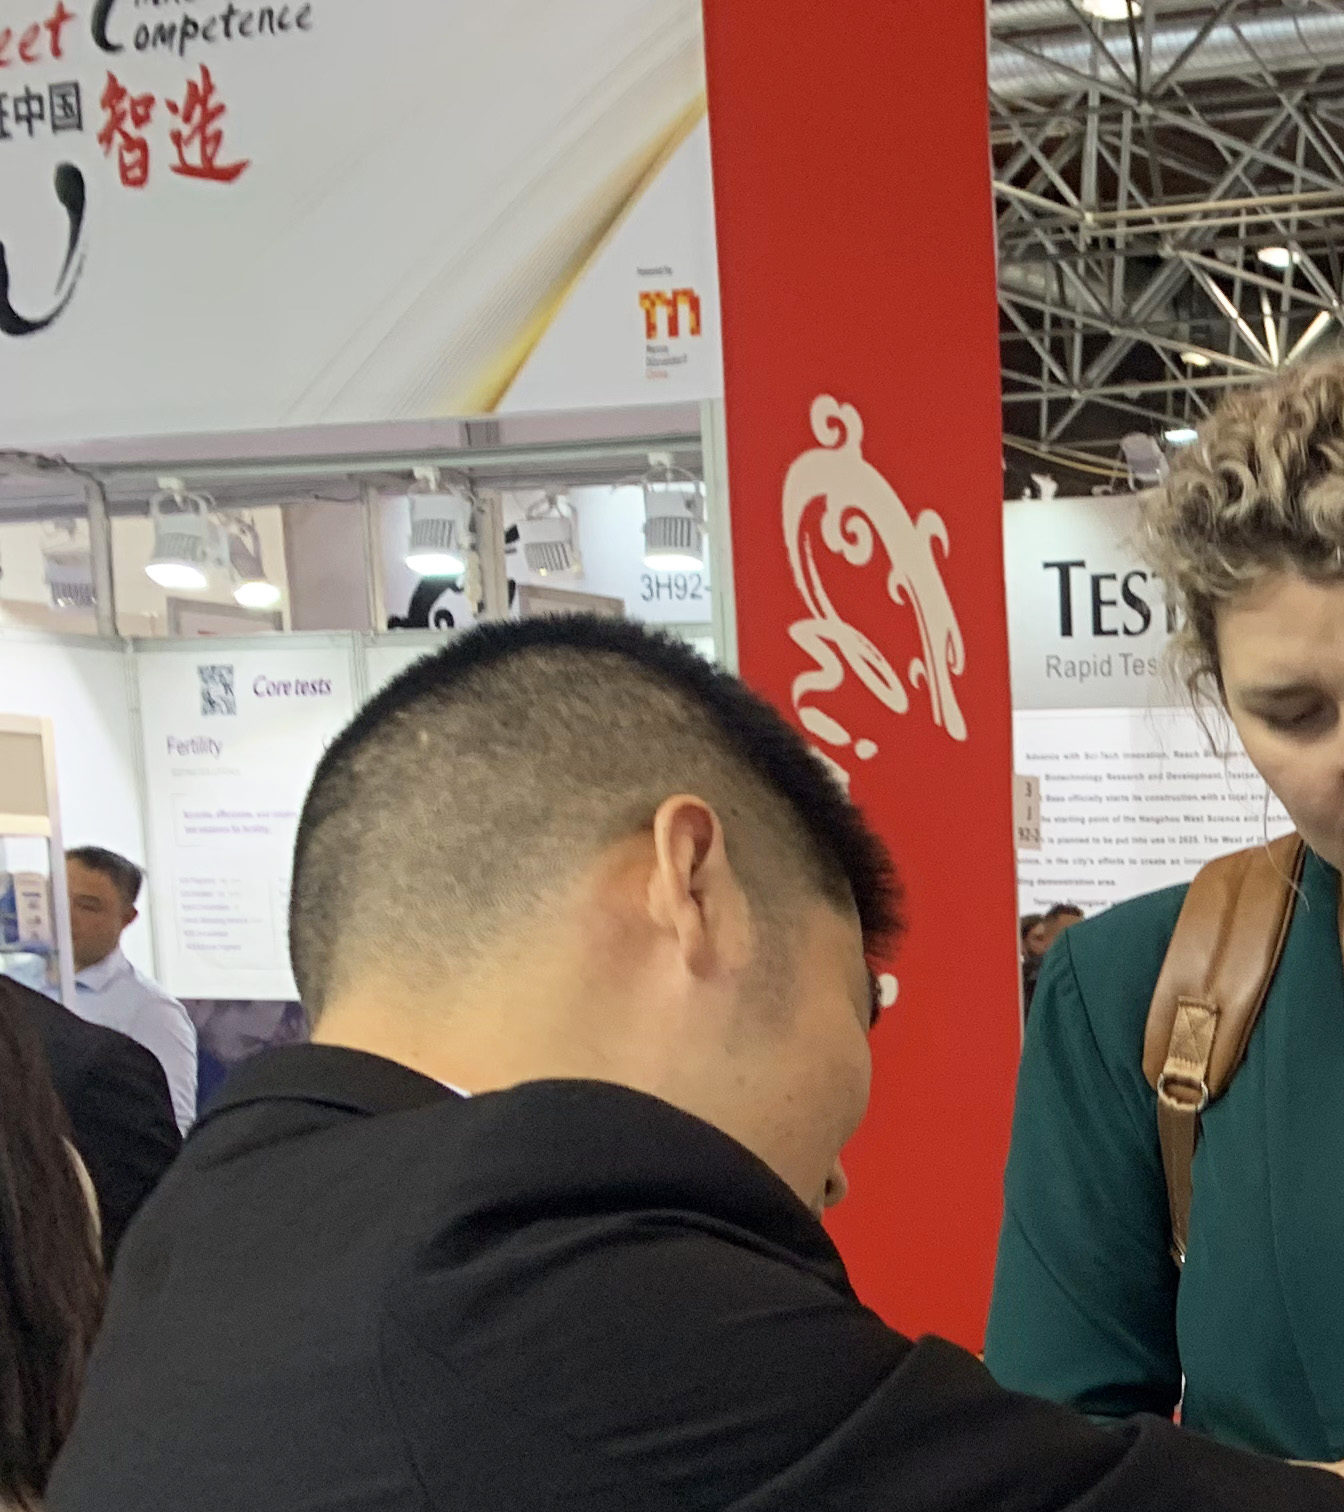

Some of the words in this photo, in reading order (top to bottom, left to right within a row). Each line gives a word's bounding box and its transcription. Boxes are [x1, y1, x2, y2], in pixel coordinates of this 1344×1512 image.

[1046, 655, 1112, 682] Rapid
[1119, 652, 1157, 677] Tes
[253, 675, 292, 698] Core
[296, 677, 333, 697] tests
[166, 735, 222, 758] Fertility
